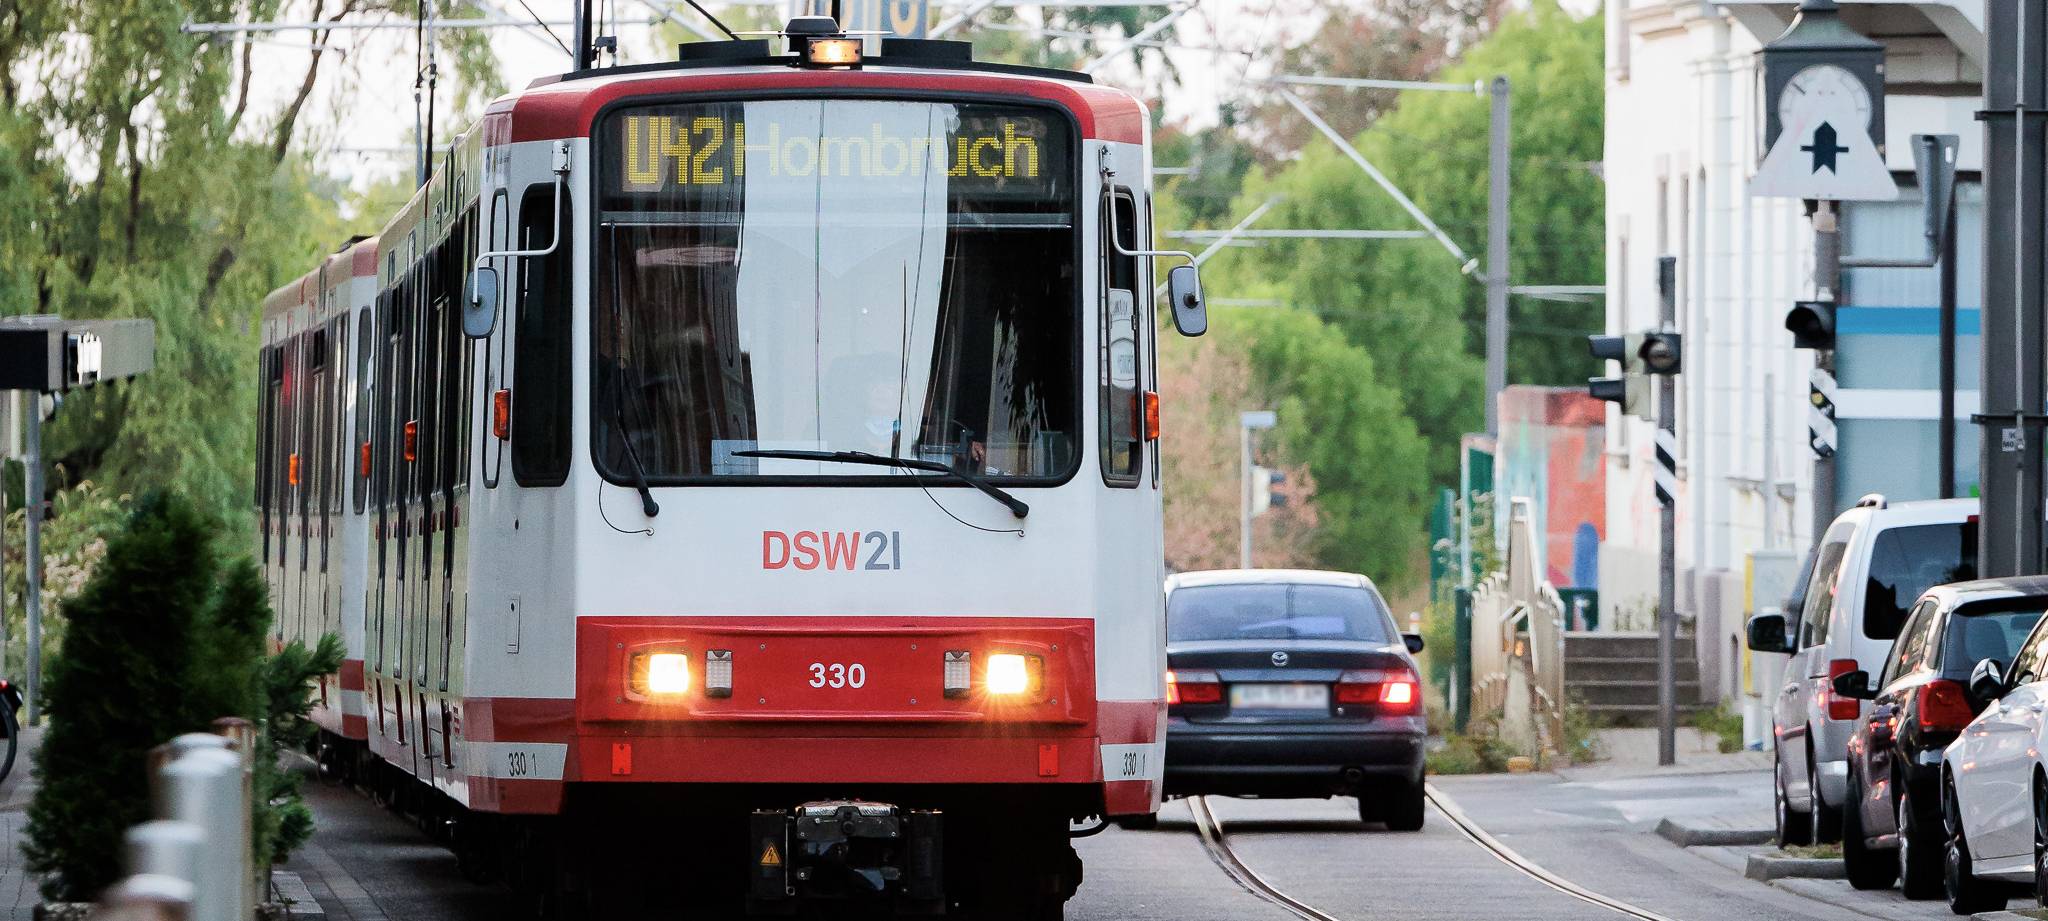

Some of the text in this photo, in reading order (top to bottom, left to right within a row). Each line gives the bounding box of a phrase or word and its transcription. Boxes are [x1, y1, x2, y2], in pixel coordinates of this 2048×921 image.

[628, 116, 1039, 184] U42 Hombruch
[808, 662, 866, 689] 330
[508, 751, 537, 777] 330 1
[1122, 752, 1137, 777] 330
